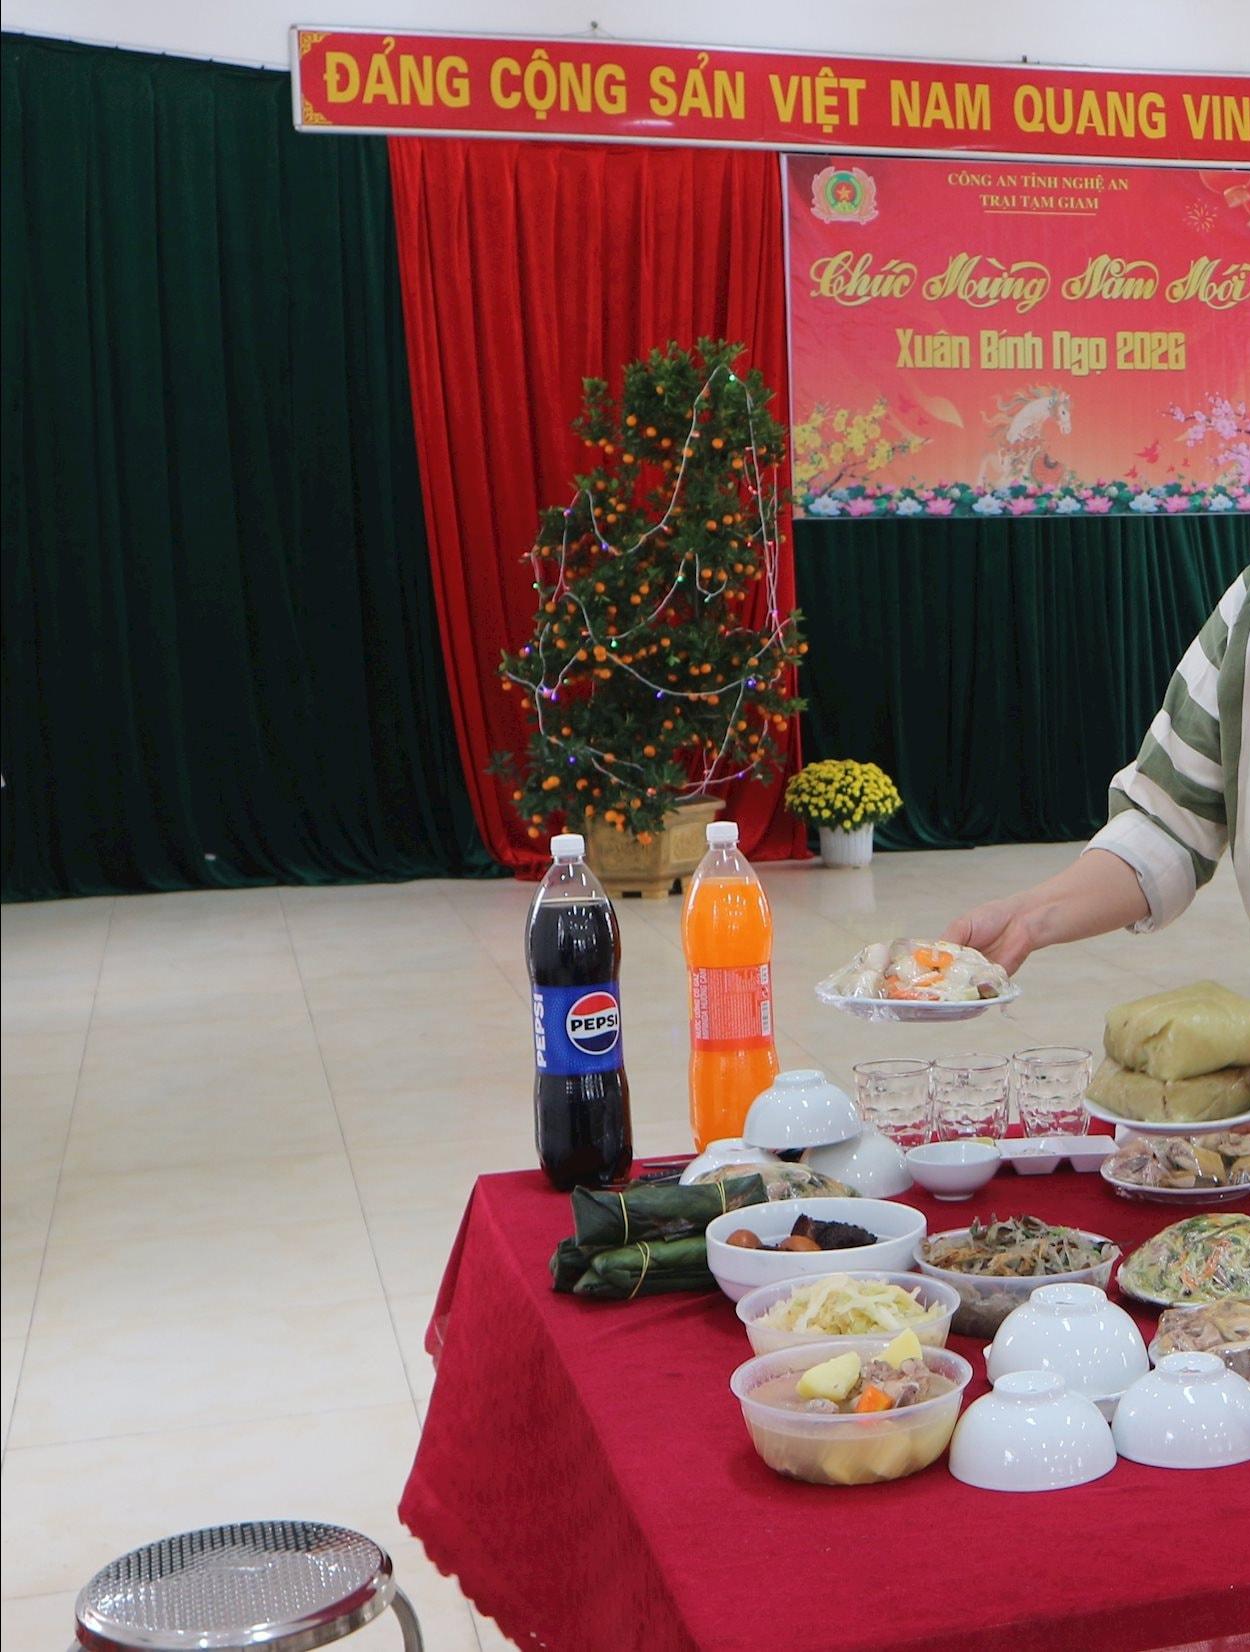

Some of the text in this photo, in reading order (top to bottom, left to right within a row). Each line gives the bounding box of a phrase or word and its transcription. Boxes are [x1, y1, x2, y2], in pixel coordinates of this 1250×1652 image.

[324, 36, 470, 108] ĐẢNG
[490, 49, 627, 120] CỘNG
[650, 52, 746, 119] SẢN
[768, 67, 866, 132] VIỆT
[891, 79, 989, 129] NAM
[1013, 84, 1167, 140] QUANG
[948, 170, 992, 186] CÔNG
[996, 175, 1017, 187] AN
[1062, 174, 1104, 192] NGHỆ
[1108, 178, 1129, 190] AN
[1020, 196, 1053, 210] TẠM
[1058, 197, 1099, 209] GIAM
[810, 250, 918, 306] Chúc
[922, 252, 1051, 314] Mừng
[1061, 254, 1160, 300] Năm
[896, 329, 1187, 376] Xuân Bính Ngọ 2026
[533, 993, 547, 1068] PEPSI
[570, 1014, 618, 1032] PEPSI
